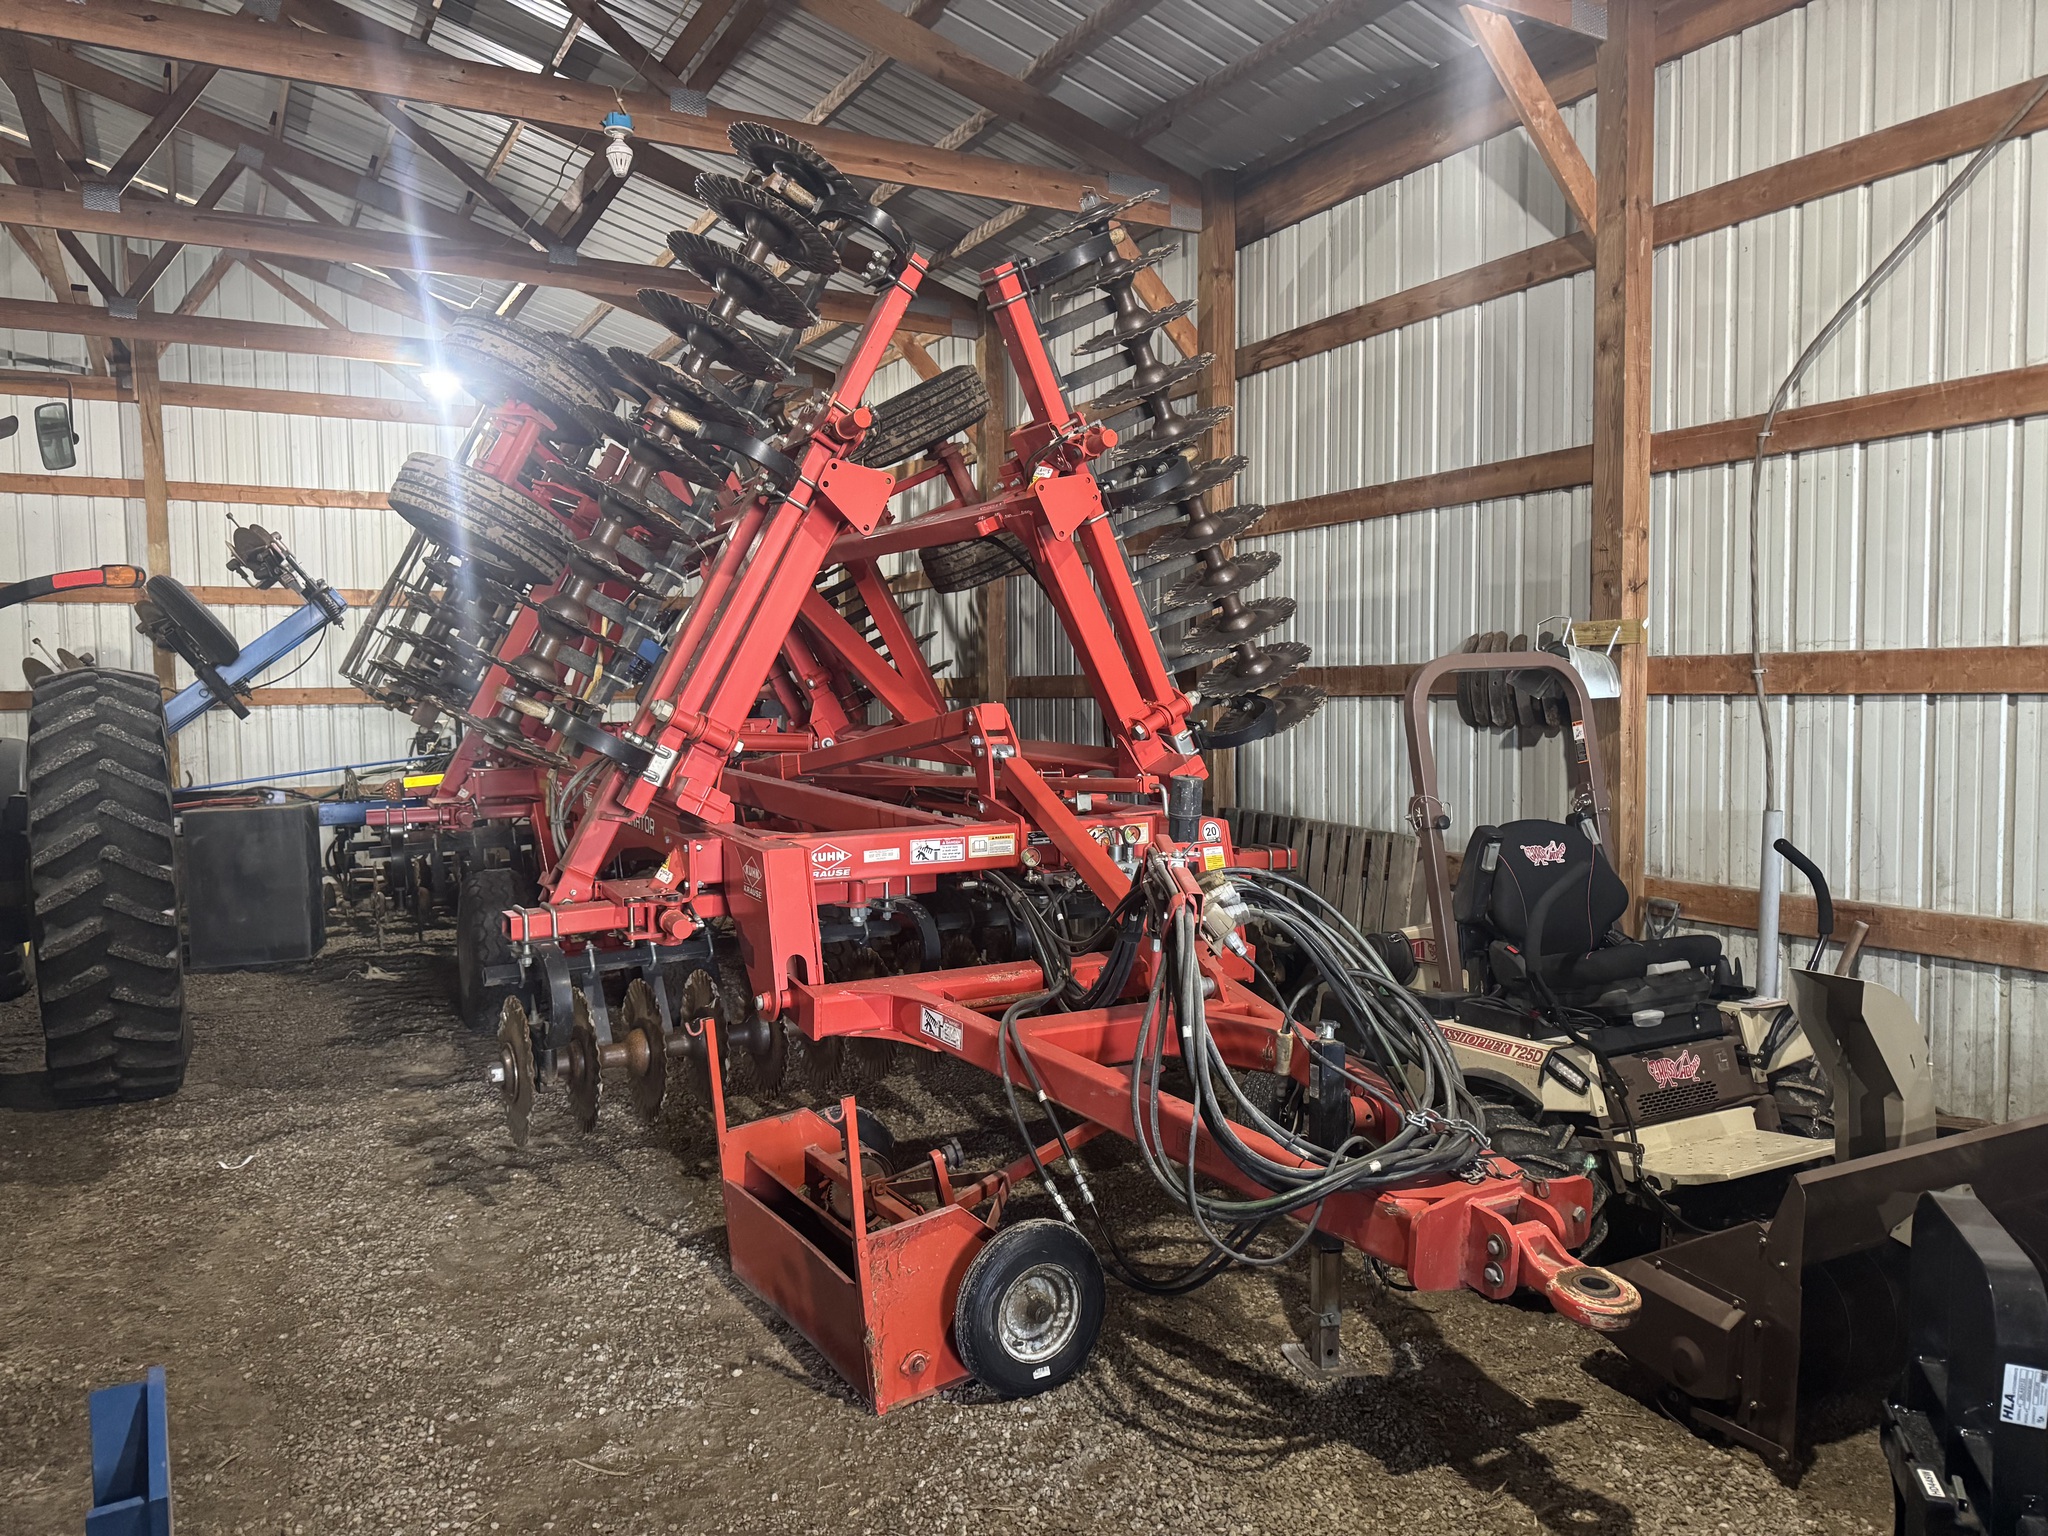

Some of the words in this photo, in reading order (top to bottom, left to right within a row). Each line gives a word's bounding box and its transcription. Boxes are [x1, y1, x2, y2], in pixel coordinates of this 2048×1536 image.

[1205, 827, 1217, 836] 20
[811, 851, 845, 862] KUHN
[744, 864, 761, 880] KUHN
[812, 868, 851, 878] RAUSE
[743, 884, 762, 899] KRAUSE
[1511, 1044, 1544, 1063] 725D
[1515, 1061, 1539, 1071] DIESEL
[2002, 1394, 2016, 1420] HLA
